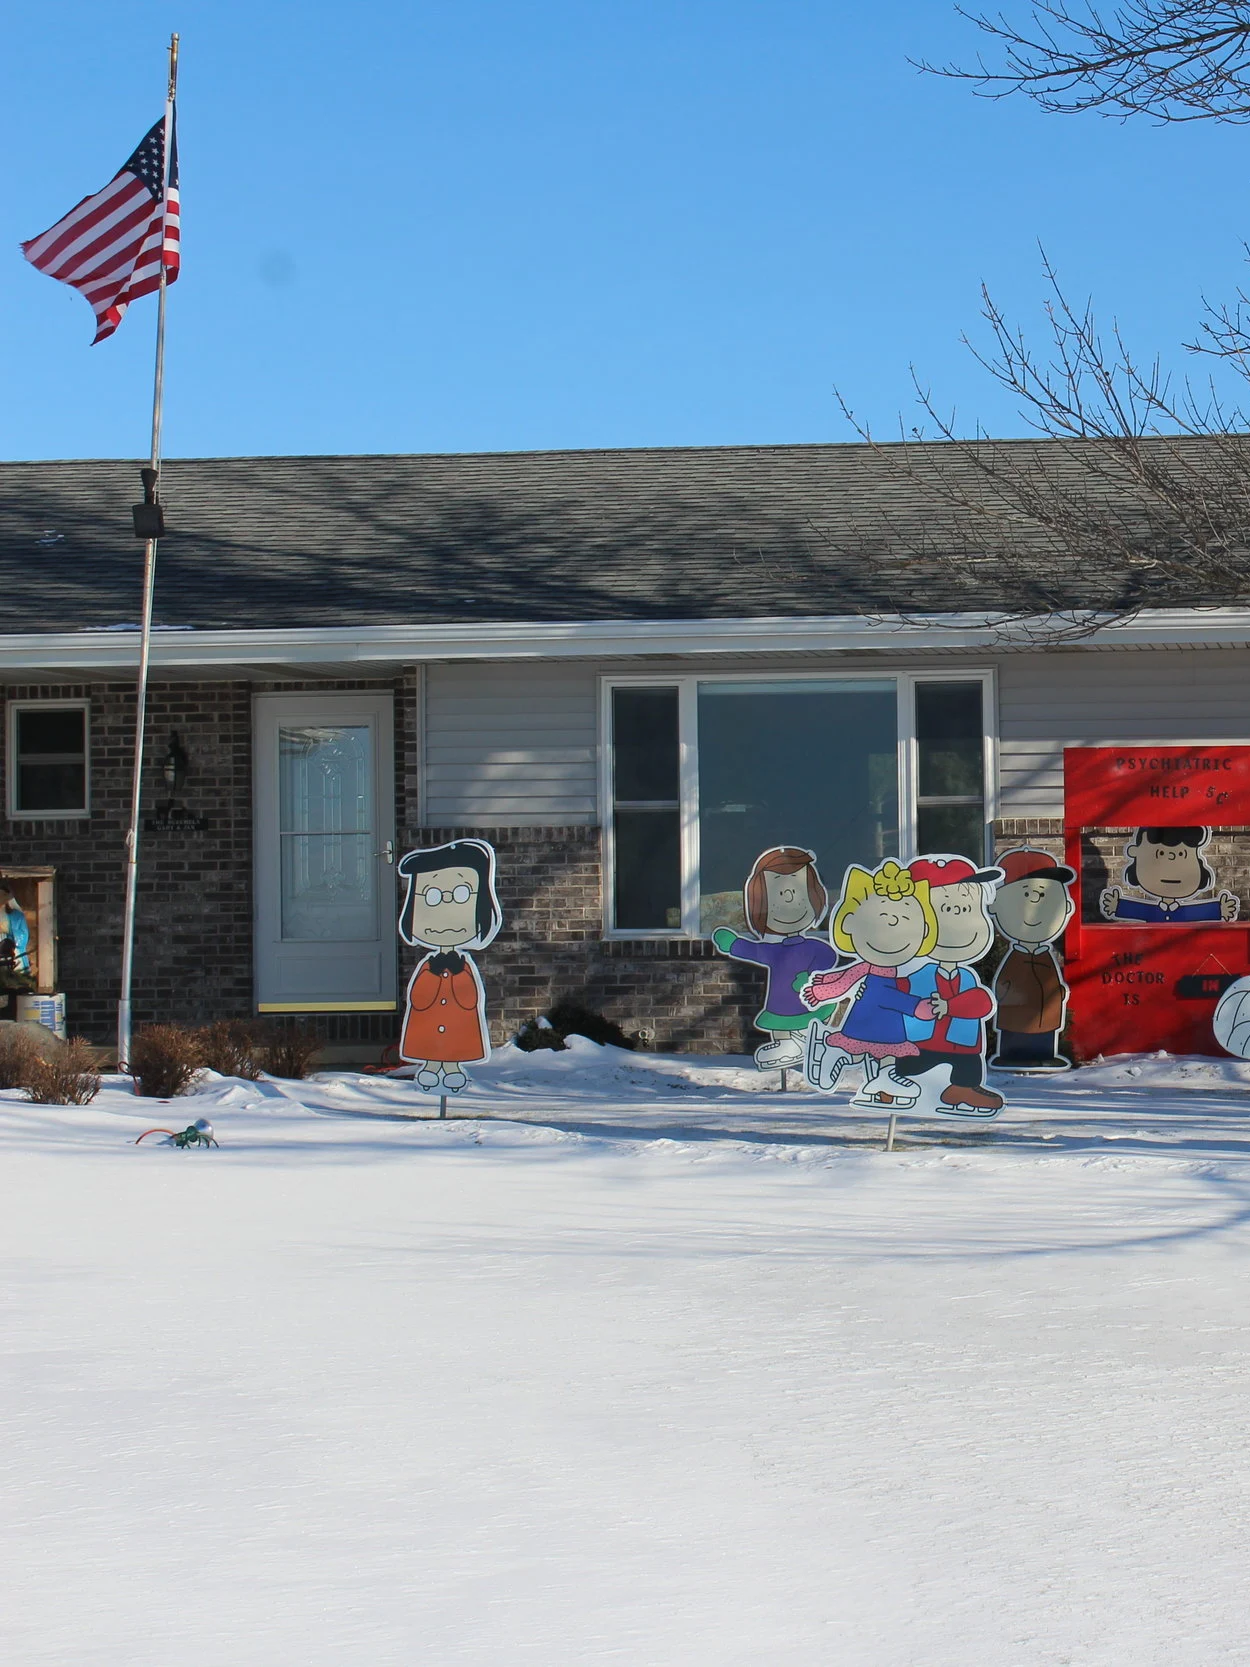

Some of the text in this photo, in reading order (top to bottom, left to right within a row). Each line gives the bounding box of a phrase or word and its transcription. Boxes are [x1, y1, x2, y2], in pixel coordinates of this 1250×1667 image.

[1116, 758, 1232, 770] PSYCHIATRIC
[1150, 786, 1189, 798] HELP
[1112, 952, 1143, 966] THE
[1102, 971, 1164, 984] DOCTOR
[1202, 979, 1219, 992] IN
[1123, 993, 1140, 1006] IS
